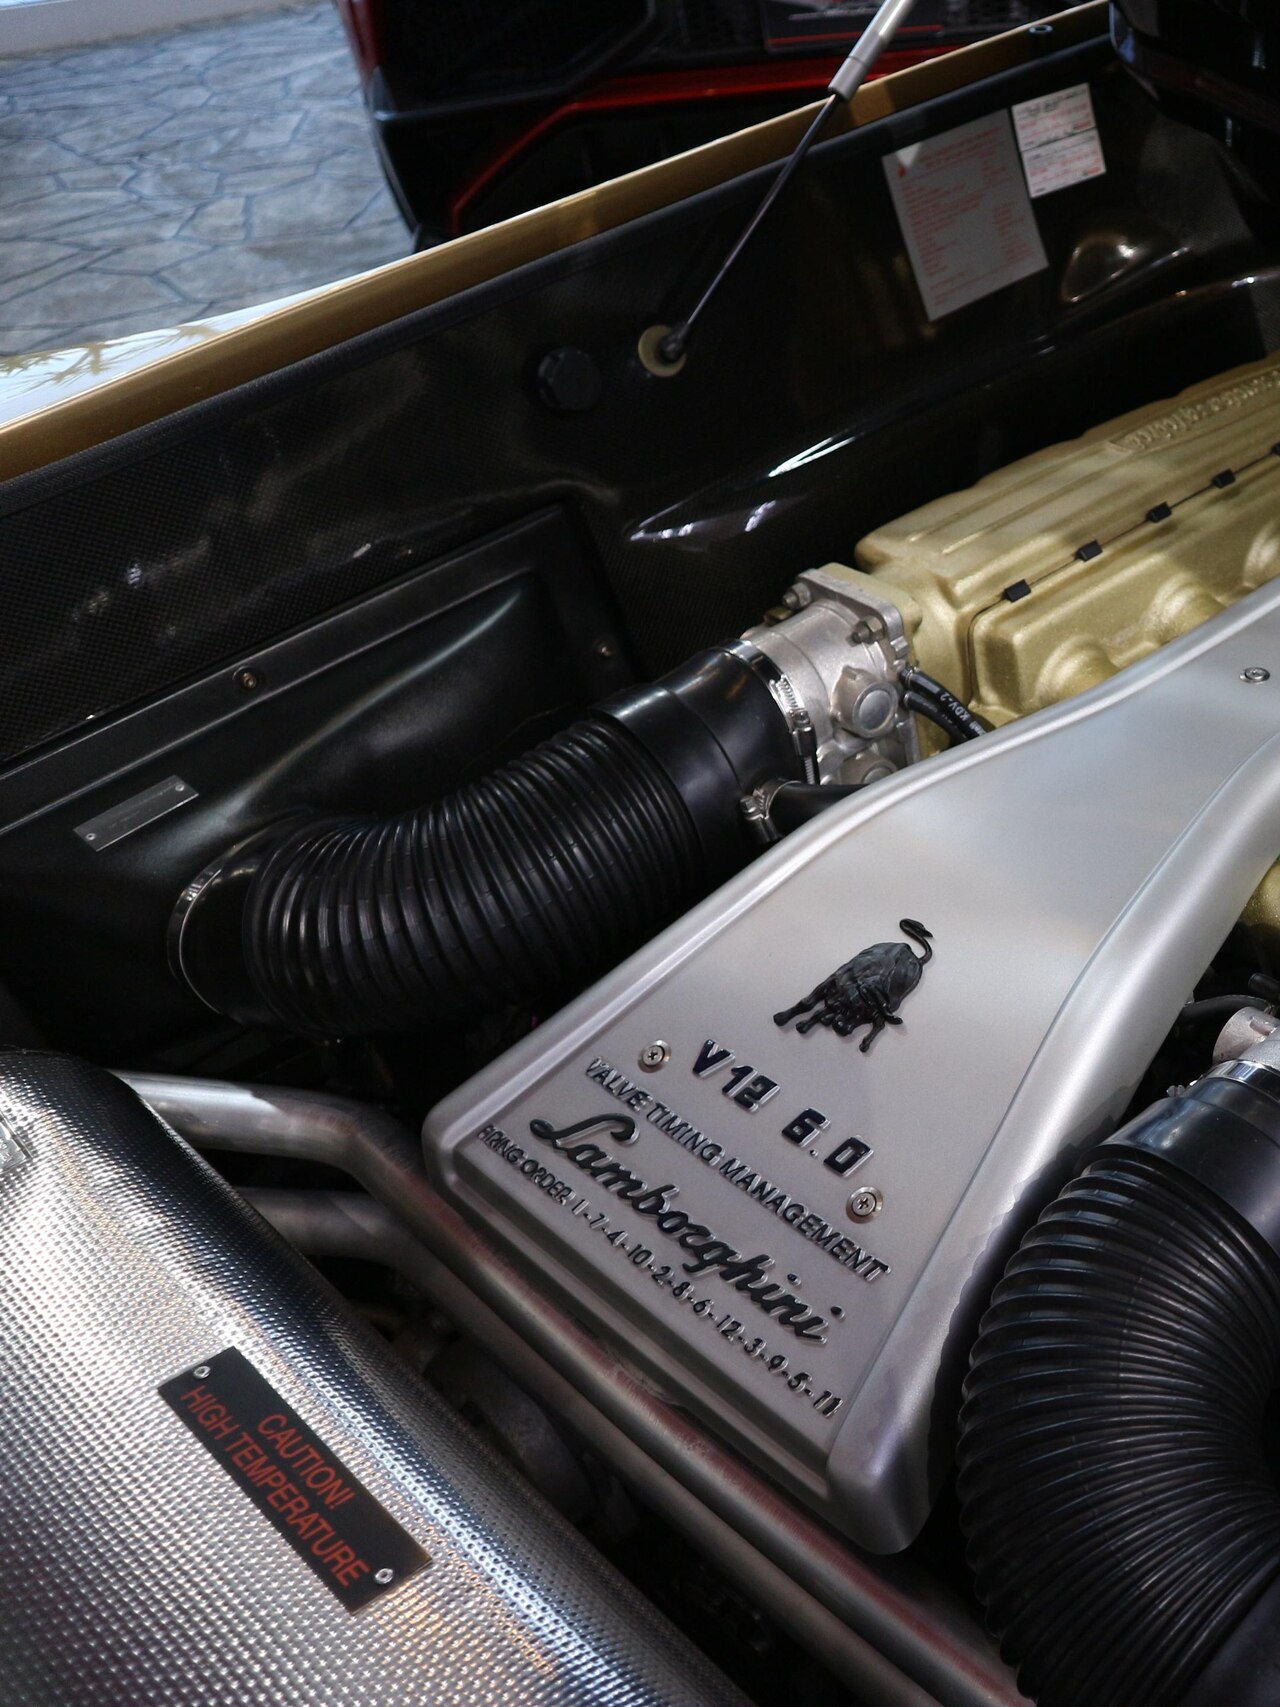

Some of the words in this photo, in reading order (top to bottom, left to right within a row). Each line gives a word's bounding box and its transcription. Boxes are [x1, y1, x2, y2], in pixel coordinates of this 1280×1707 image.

[519, 1158, 577, 1206] ORDER
[585, 1057, 653, 1112] VALVE
[646, 1101, 726, 1167] TIMING
[719, 1157, 892, 1283] MANAGEMENT
[692, 1039, 781, 1113] V12
[781, 1107, 874, 1178] 6.0
[529, 1112, 846, 1345] Lamborghini
[180, 1384, 241, 1441] HIGH
[224, 1431, 371, 1588] TEMPERATURE
[256, 1412, 356, 1511] CAUTION!
